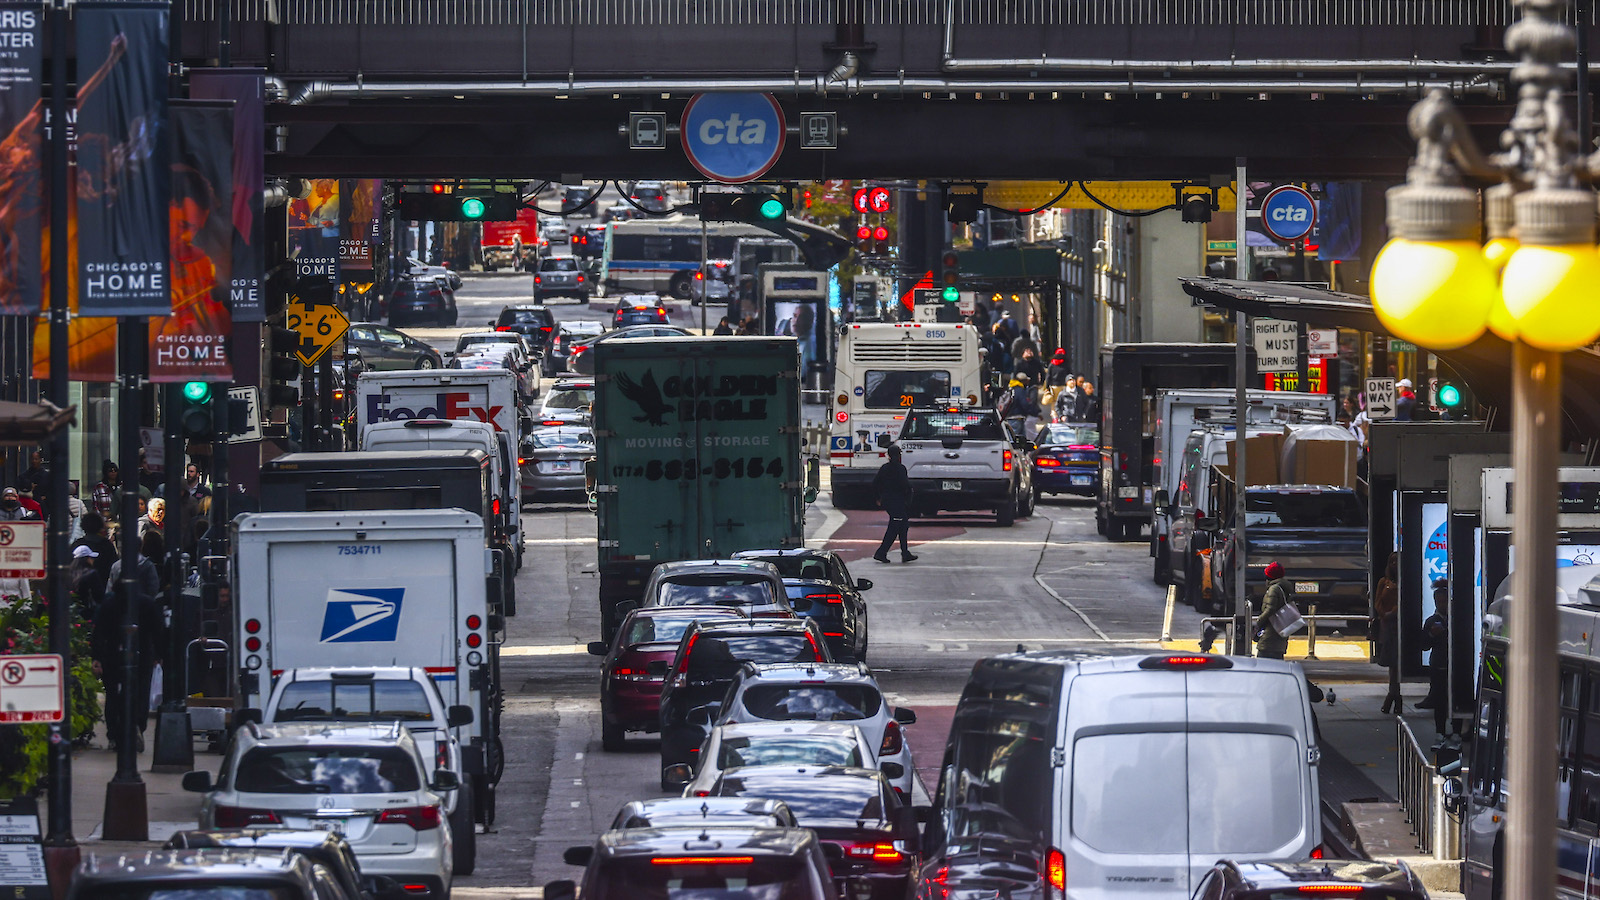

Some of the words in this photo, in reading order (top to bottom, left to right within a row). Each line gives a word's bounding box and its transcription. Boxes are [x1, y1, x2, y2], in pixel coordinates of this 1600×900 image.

[0, 11, 35, 28] RIS
[699, 113, 767, 145] cta
[1272, 205, 1307, 222] cta
[86, 262, 162, 272] CHICAGO'S
[87, 274, 162, 298] HOME
[926, 330, 946, 339] 8150
[1256, 324, 1279, 334] RIGHT
[157, 335, 225, 343] CHICAGO'S
[1265, 339, 1296, 350] MUST
[158, 345, 225, 366] HOME
[1257, 357, 1279, 366] TURN
[663, 375, 777, 397] GOLDEN
[1369, 381, 1392, 392] ONE
[900, 395, 914, 407] 20
[1368, 392, 1393, 403] WAY
[367, 392, 504, 432] FedEx
[678, 399, 767, 421] EAGLE
[625, 437, 682, 449] MOVING
[685, 438, 696, 449] &
[703, 435, 770, 447] STORAGE
[337, 545, 382, 556] 7534711
